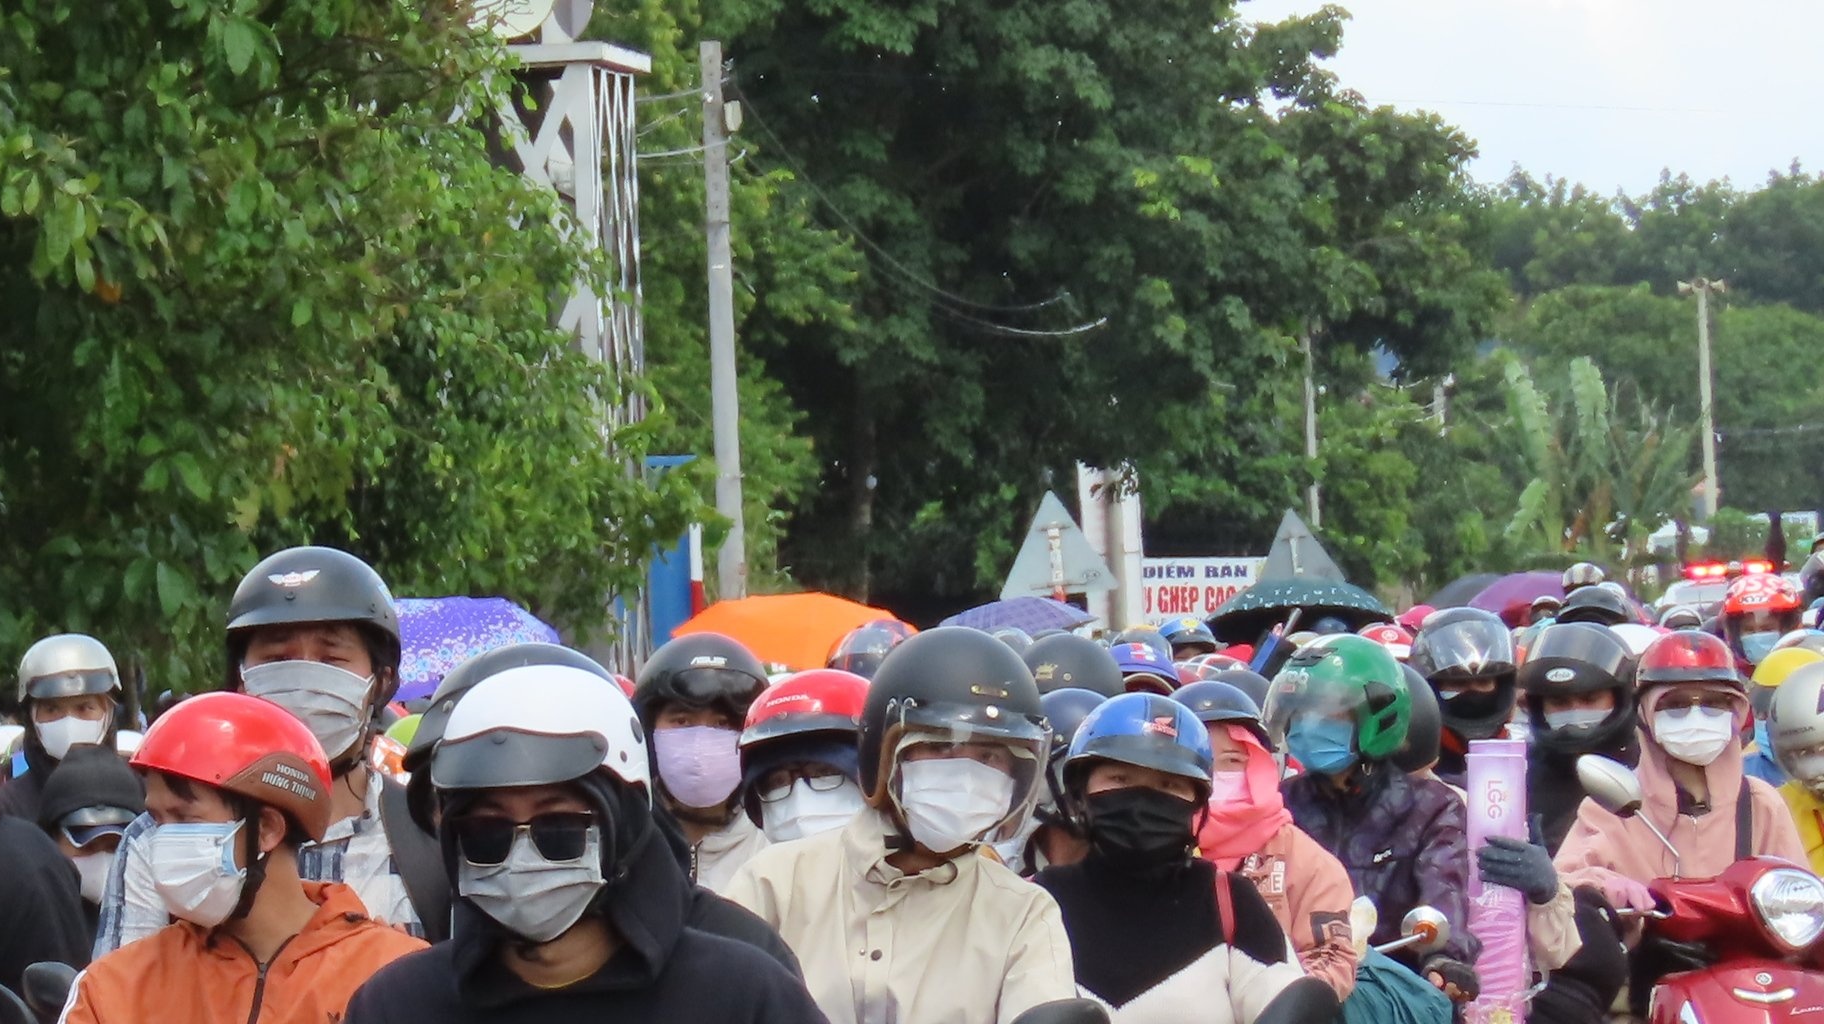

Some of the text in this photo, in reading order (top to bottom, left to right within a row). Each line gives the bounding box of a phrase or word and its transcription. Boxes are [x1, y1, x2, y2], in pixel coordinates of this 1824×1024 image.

[1158, 582, 1199, 613] GHÉP
[766, 694, 811, 708] HONDA
[276, 763, 309, 782] HONDA
[1487, 780, 1503, 819] LGG
